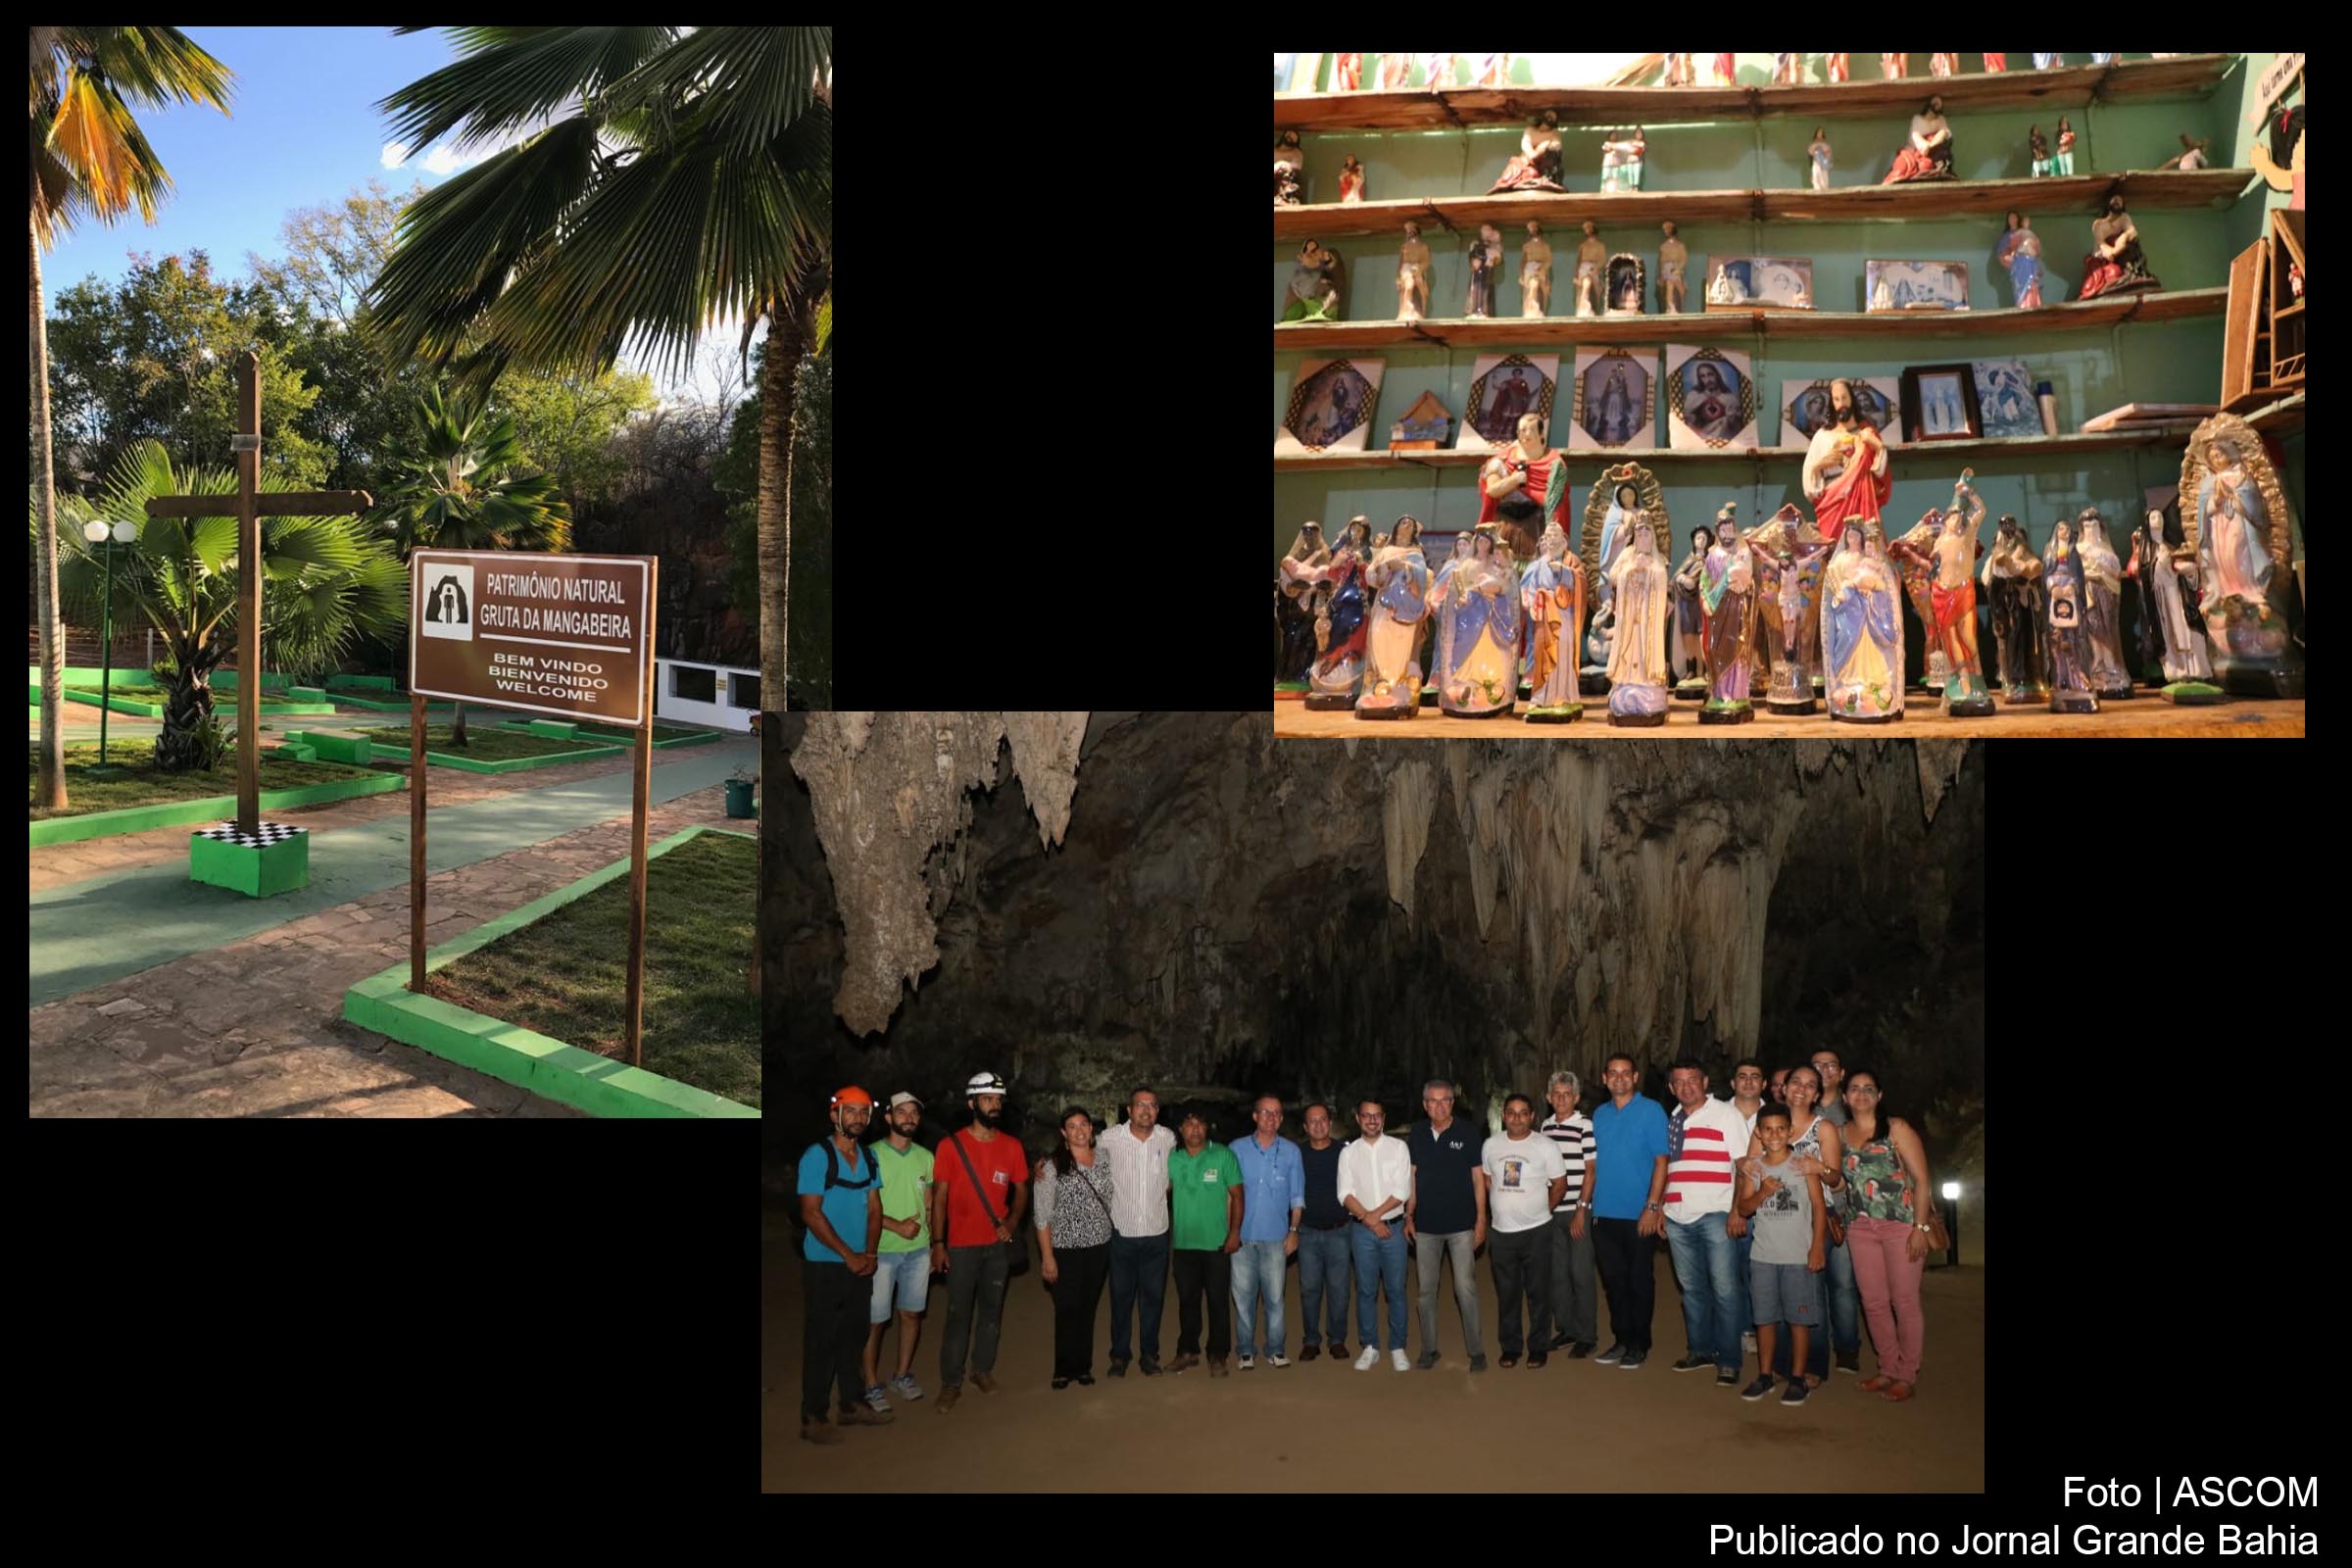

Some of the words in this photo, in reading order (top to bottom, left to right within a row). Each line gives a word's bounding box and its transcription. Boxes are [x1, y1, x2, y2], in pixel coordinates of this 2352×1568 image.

[487, 570, 560, 599] PATRIMÔNIO
[564, 577, 625, 604] NATURAL
[480, 604, 520, 628] GRUTA
[523, 608, 540, 630] DA
[543, 610, 631, 638] MANGABEIRA
[494, 653, 534, 667] BEM
[540, 659, 603, 674] VINDO
[489, 665, 609, 689] BIENVENIDO
[496, 678, 597, 703] WELCOME
